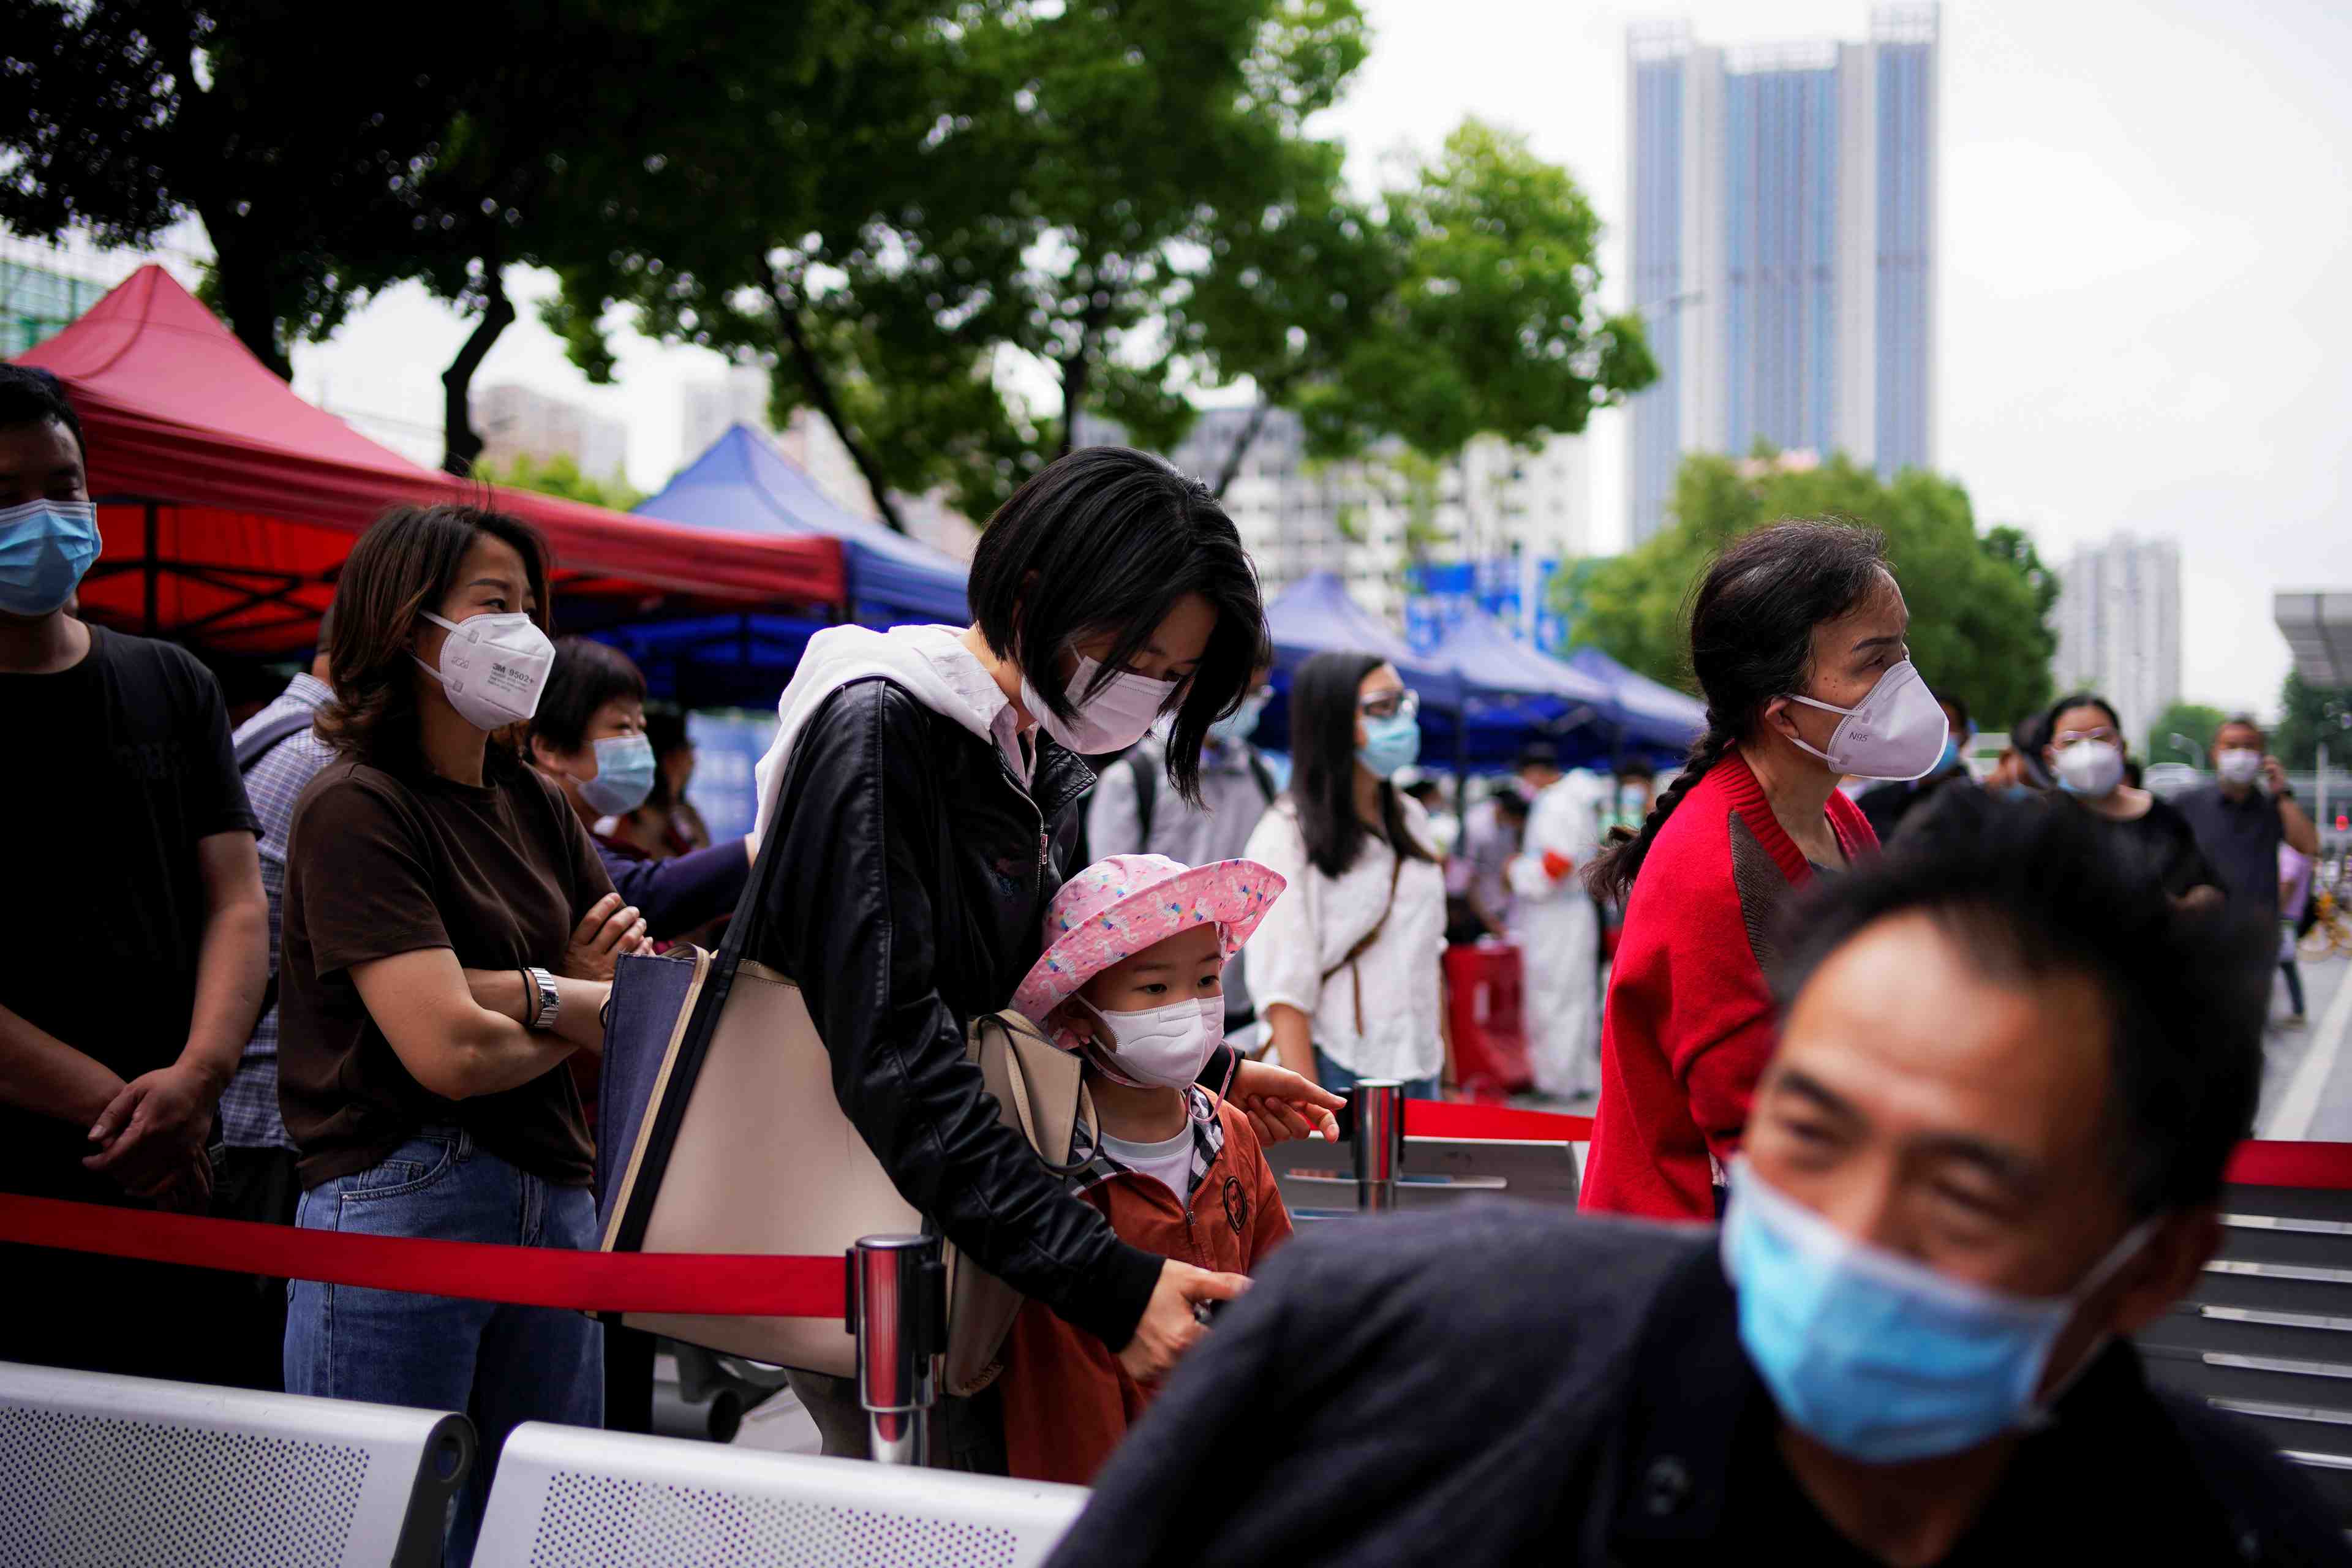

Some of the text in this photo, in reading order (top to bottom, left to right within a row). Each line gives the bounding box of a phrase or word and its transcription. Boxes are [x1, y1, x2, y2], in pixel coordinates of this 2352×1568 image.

[492, 663, 506, 673] 3M
[510, 669, 534, 683] 9502+
[1849, 732, 1868, 742] N95
